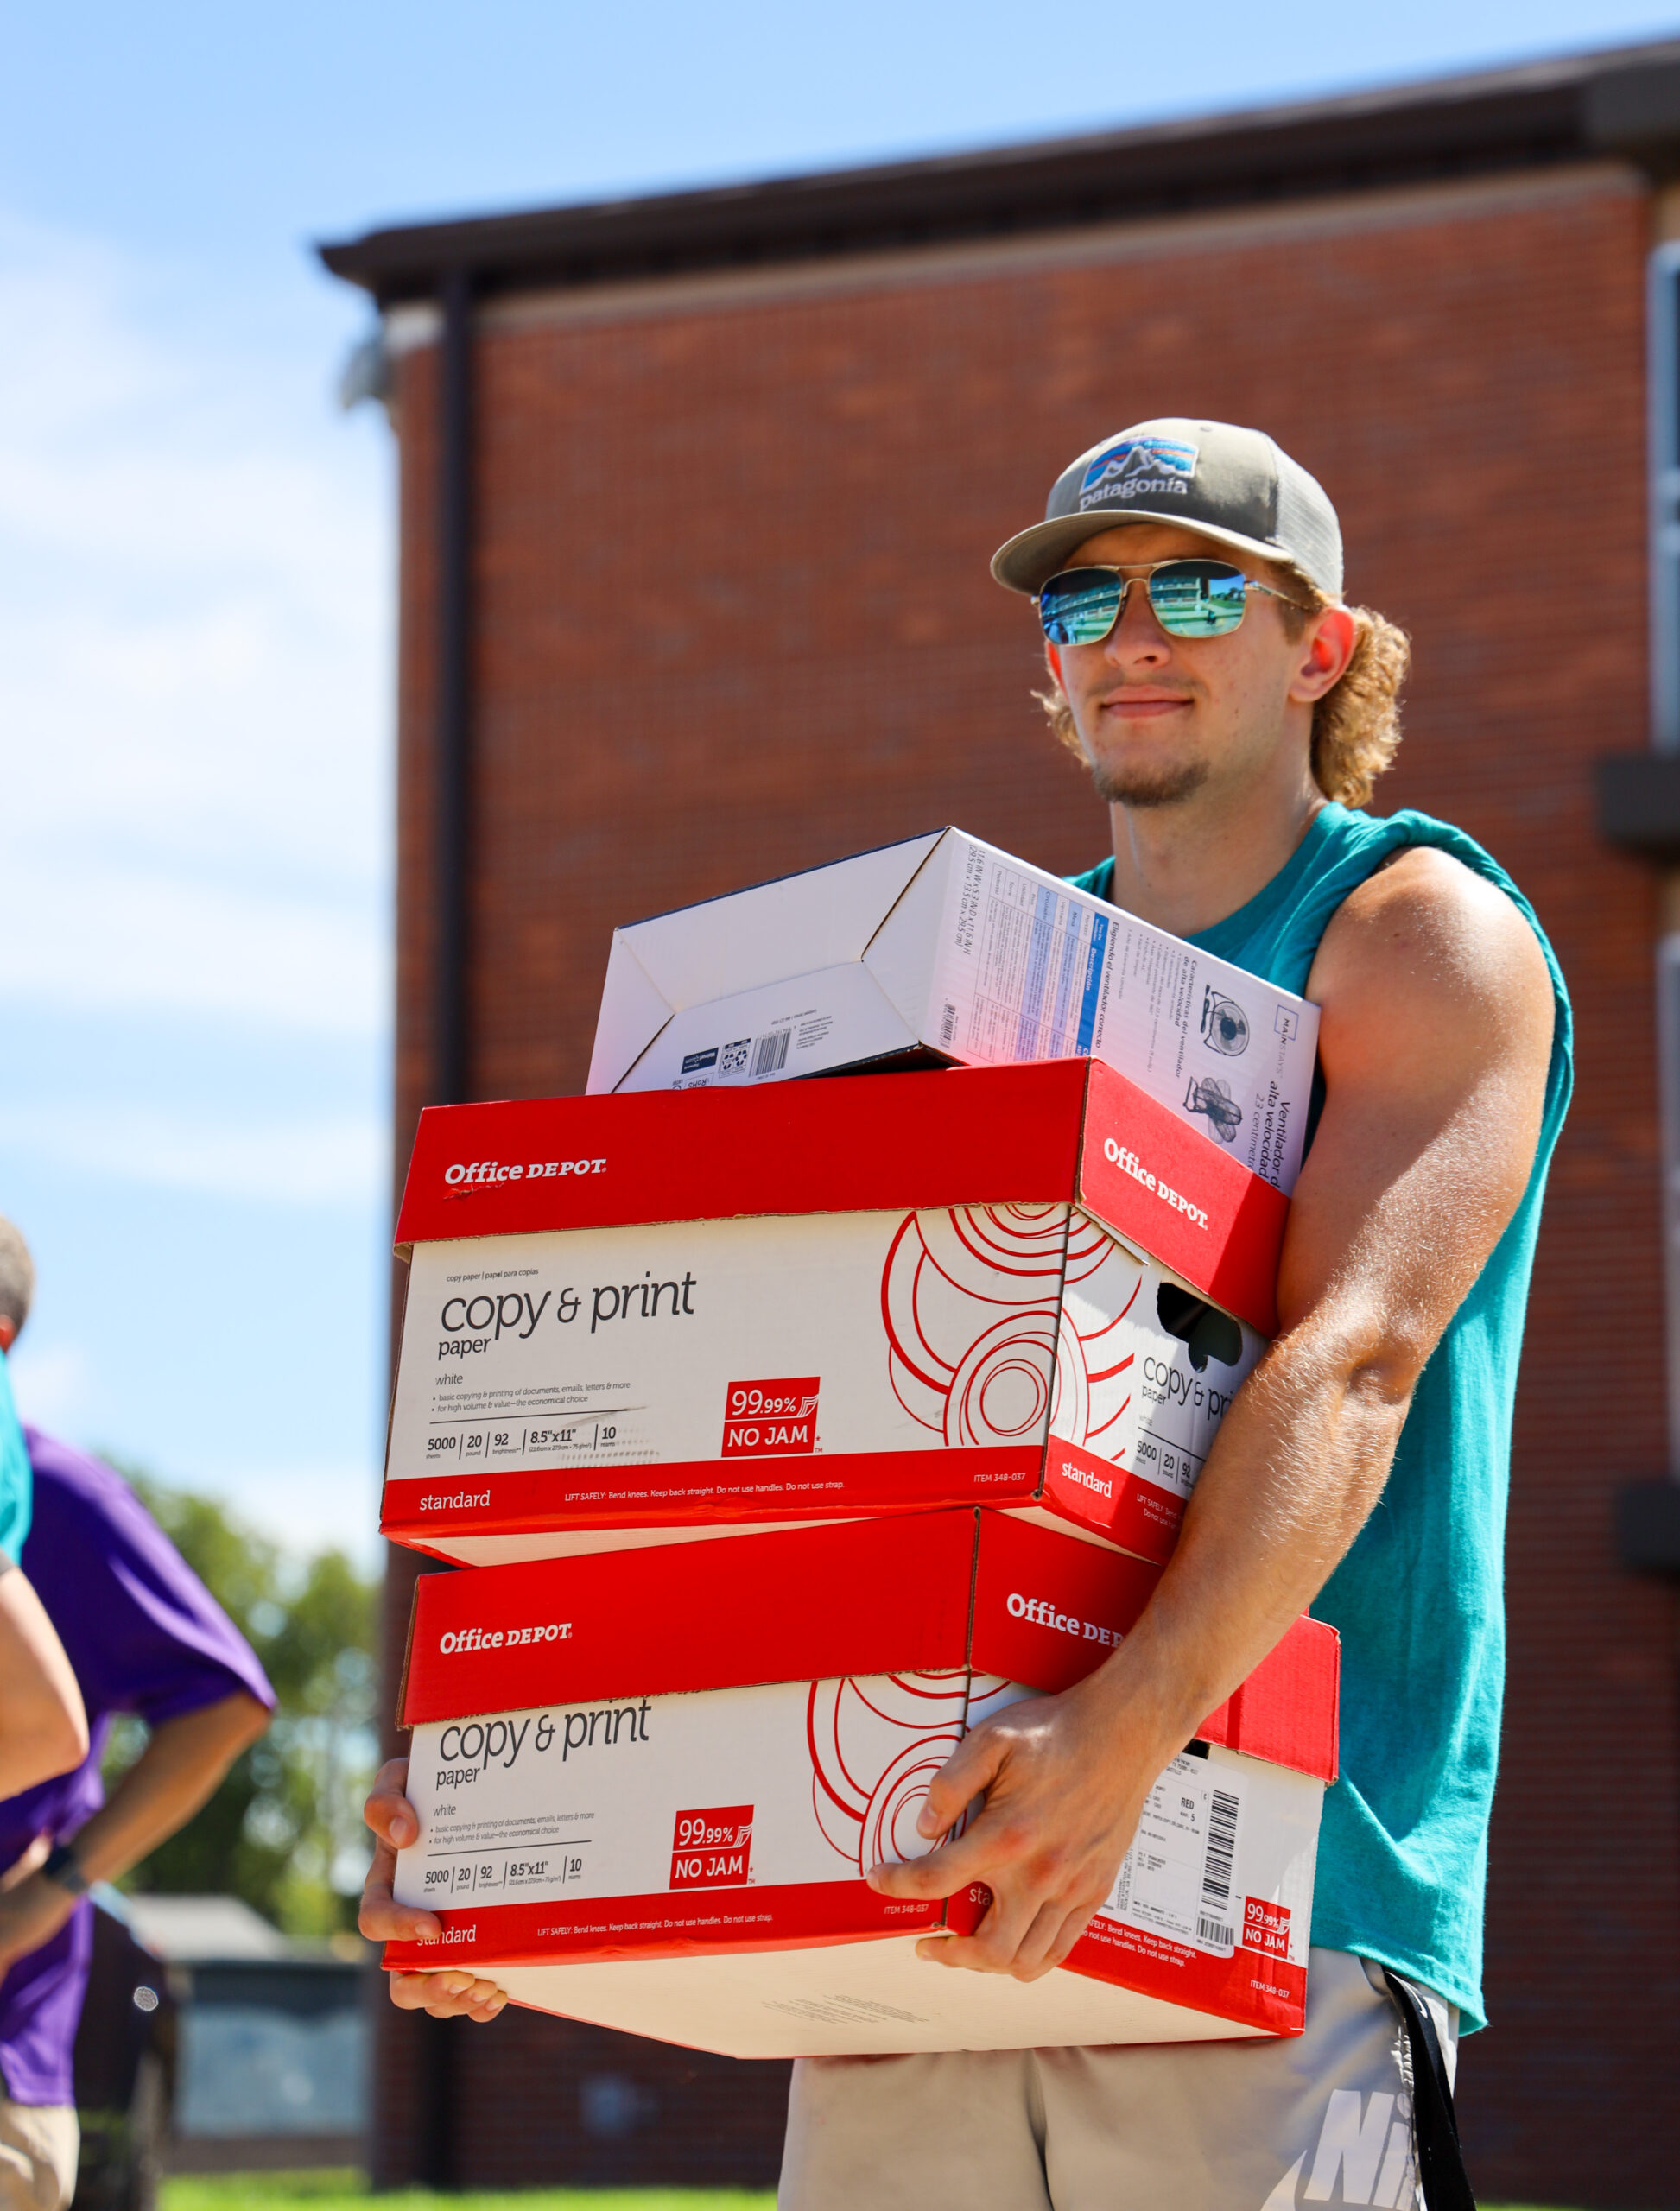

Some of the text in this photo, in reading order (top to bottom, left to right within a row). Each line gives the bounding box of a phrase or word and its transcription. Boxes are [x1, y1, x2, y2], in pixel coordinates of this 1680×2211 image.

[1080, 477, 1188, 511] patagonia
[1086, 947, 1096, 991] Descripción
[1183, 956, 1189, 966] de
[1095, 921, 1119, 1048] Eligiendo el ventilador correcto
[1175, 987, 1184, 1027] velocidad
[1255, 1093, 1265, 1109] 23
[1258, 1080, 1279, 1178] alta velocidad
[1271, 1102, 1290, 1175] Ventilador
[444, 1158, 606, 1184] Office DEPOT
[1104, 1137, 1208, 1228] Office DEPOT
[462, 1273, 480, 1282] paper
[485, 1270, 503, 1280] papel
[518, 1268, 539, 1277] copias
[441, 1271, 697, 1340] copy & print
[438, 1337, 491, 1360] paper
[435, 1373, 463, 1385] white
[1144, 1356, 1233, 1420] copy & pr
[447, 1403, 461, 1413] high
[527, 1396, 566, 1405] economical
[455, 1392, 482, 1401] copying
[488, 1390, 514, 1399] printing
[732, 1389, 796, 1416] 99.99%
[1142, 1384, 1166, 1406] paper
[428, 1436, 456, 1450] 5000
[466, 1435, 482, 1448] 20
[494, 1433, 509, 1446] 92
[601, 1426, 616, 1439] 10
[727, 1424, 808, 1447] NO JAM
[1137, 1440, 1191, 1479] 5000 20 92
[973, 1472, 1026, 1482] ITEM 348-037
[1062, 1461, 1112, 1498] standard
[419, 1489, 491, 1511] standard
[564, 1492, 580, 1501] LIFT
[580, 1492, 606, 1500] SAFELY:
[608, 1491, 626, 1499] Bend
[650, 1489, 668, 1498] Keep
[669, 1487, 686, 1496] back
[687, 1486, 713, 1496] straight.
[755, 1483, 784, 1492] handles.
[785, 1482, 796, 1491] Do
[1006, 1593, 1080, 1635] Office
[440, 1622, 572, 1654] Office DEPOT
[439, 1700, 651, 1769] copy & print
[435, 1765, 480, 1790] paper
[433, 1804, 456, 1816] white
[1181, 1796, 1195, 1810] RED
[1191, 1813, 1195, 1822] 5
[679, 1818, 733, 1846] 99.99%
[425, 1869, 449, 1884] 5000
[458, 1867, 471, 1881] 20
[480, 1866, 492, 1879] 92
[569, 1858, 582, 1872] 10
[675, 1855, 743, 1878] NO JAM
[884, 1904, 929, 1914] ITEM 348-037
[1247, 1903, 1278, 1932] 99.99%
[537, 1928, 550, 1936] LIFT
[574, 1924, 589, 1934] Bend
[608, 1923, 624, 1932] Keep
[663, 1919, 673, 1928] Do
[1107, 1923, 1123, 1935] Bend
[1143, 1935, 1157, 1947] Keep
[1158, 1940, 1172, 1951] back
[1245, 1928, 1284, 1951] NO JAM
[1250, 1980, 1290, 1998] ITEM 348-037
